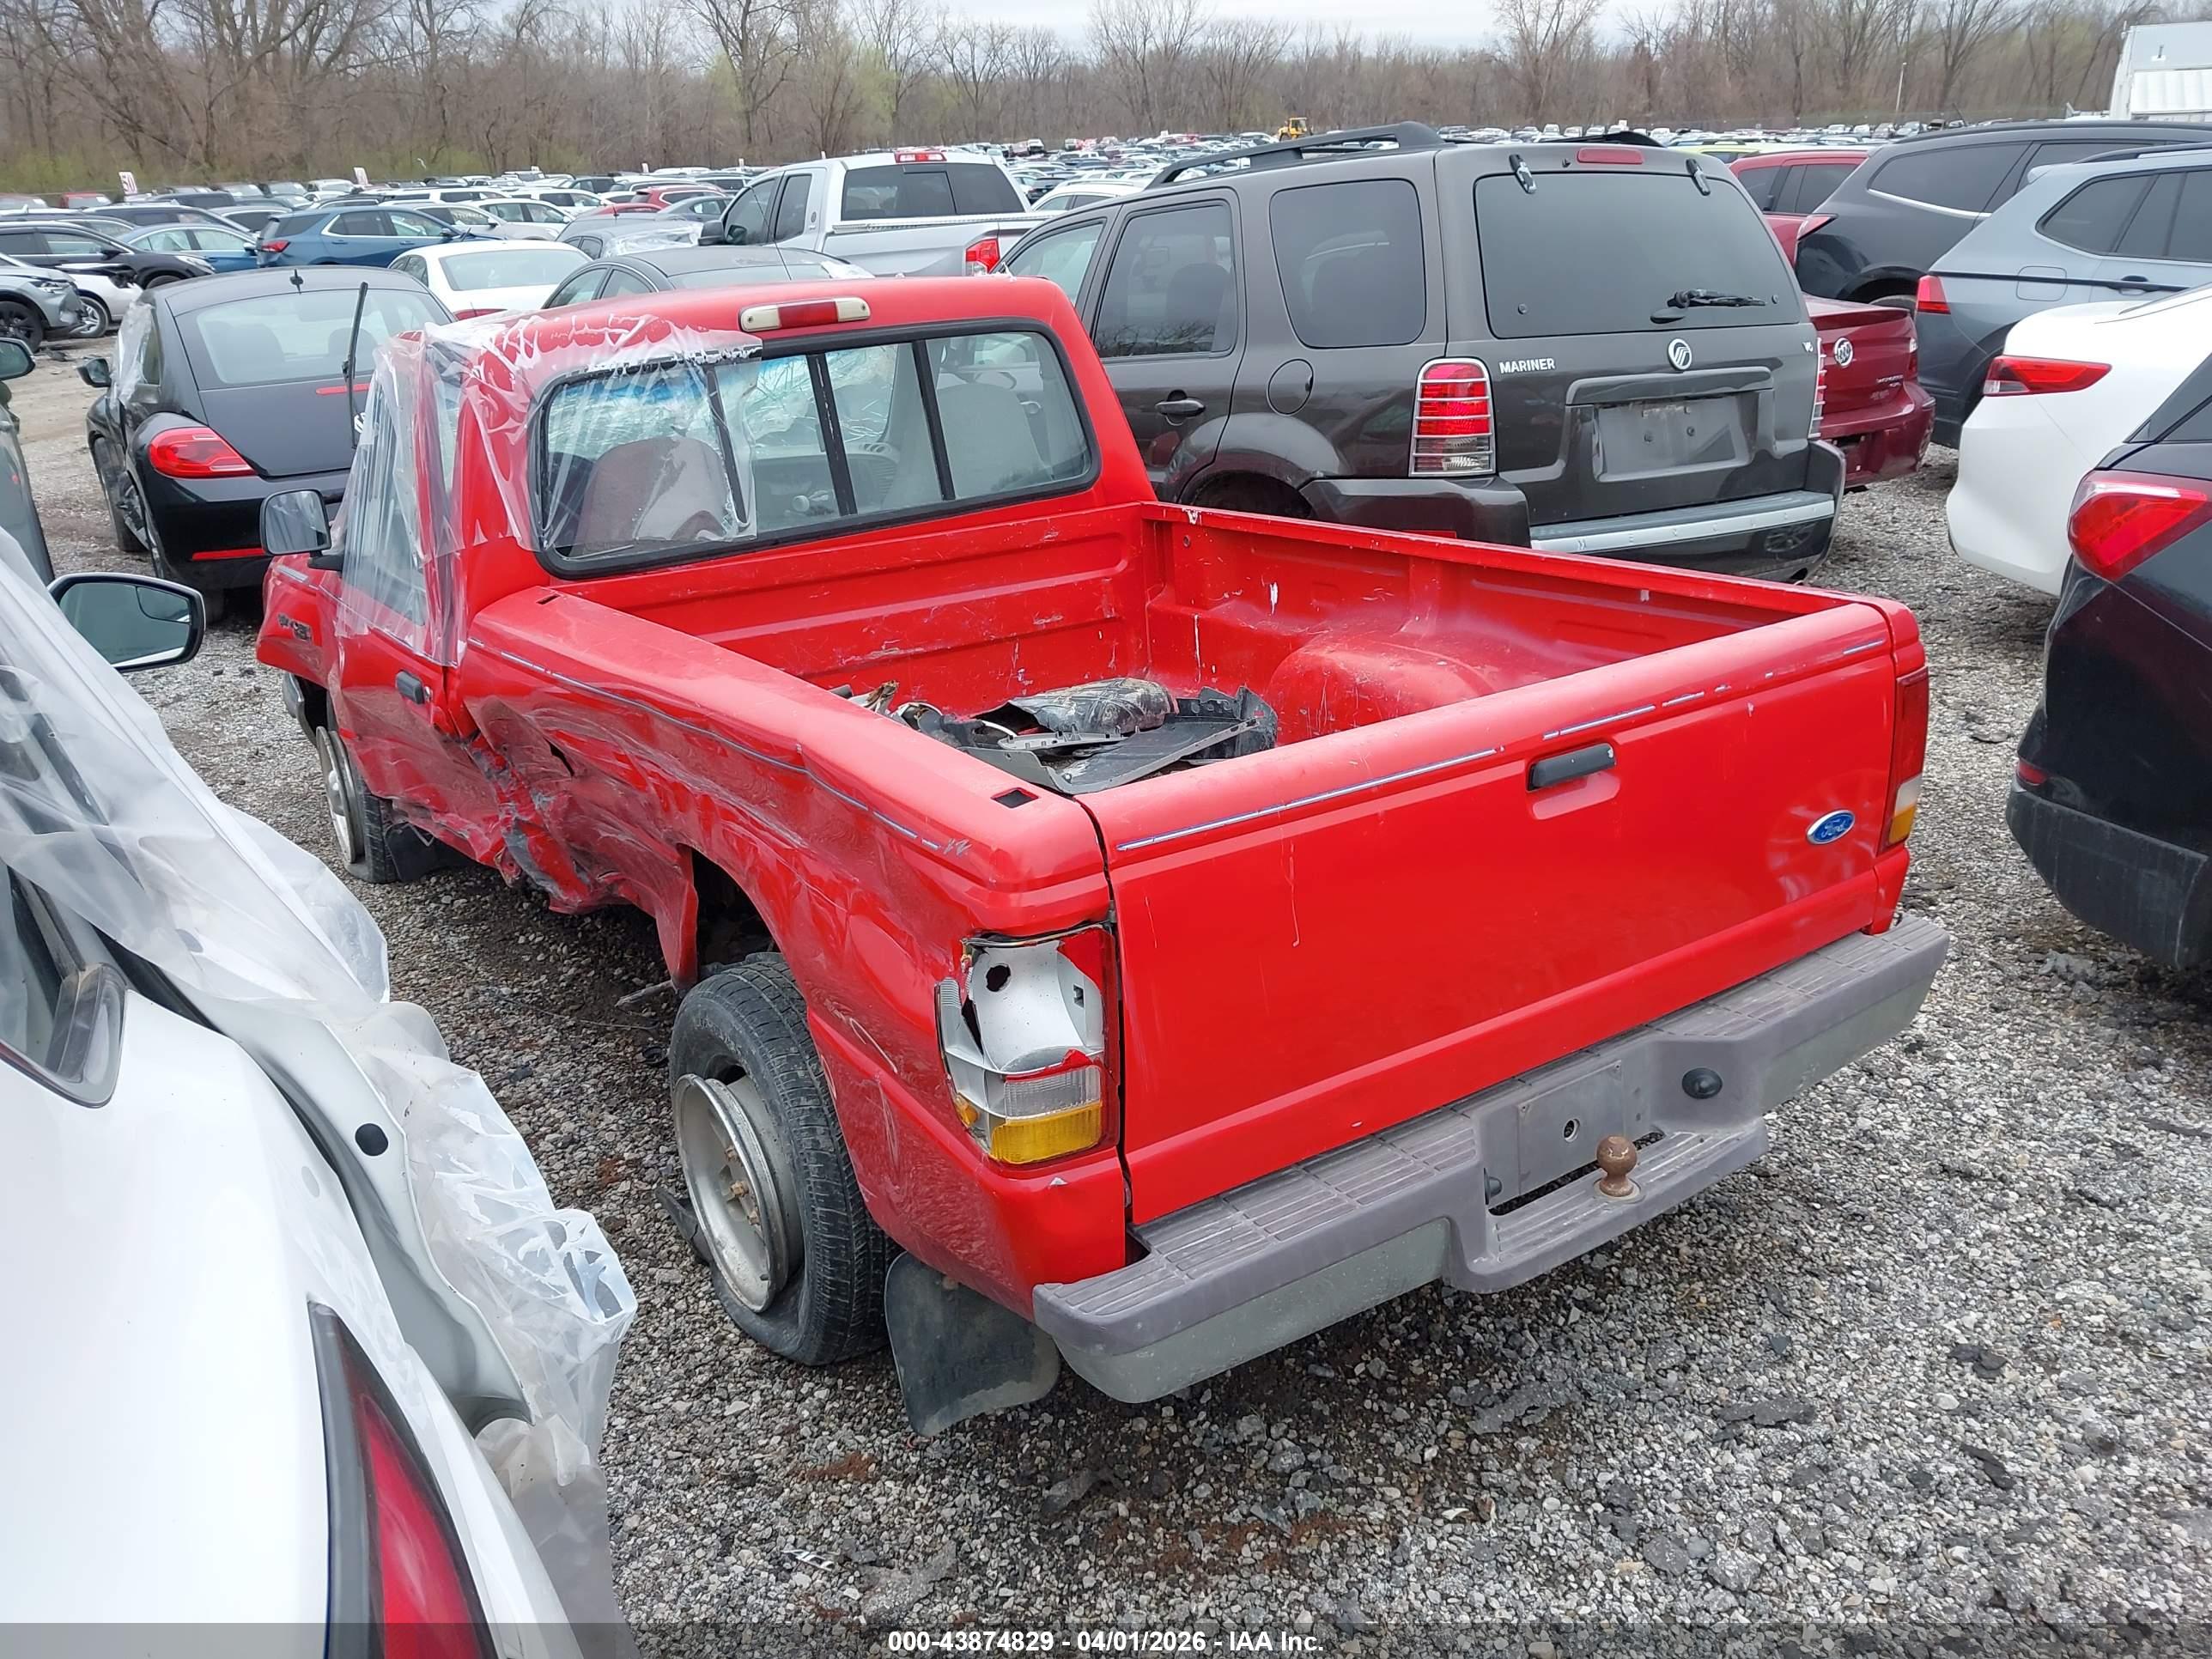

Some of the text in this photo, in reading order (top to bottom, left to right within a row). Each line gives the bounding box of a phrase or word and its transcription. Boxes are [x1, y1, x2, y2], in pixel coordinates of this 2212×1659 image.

[1802, 341, 1814, 352] V6
[1498, 357, 1555, 374] MARINER
[1817, 816, 1850, 841] Ford
